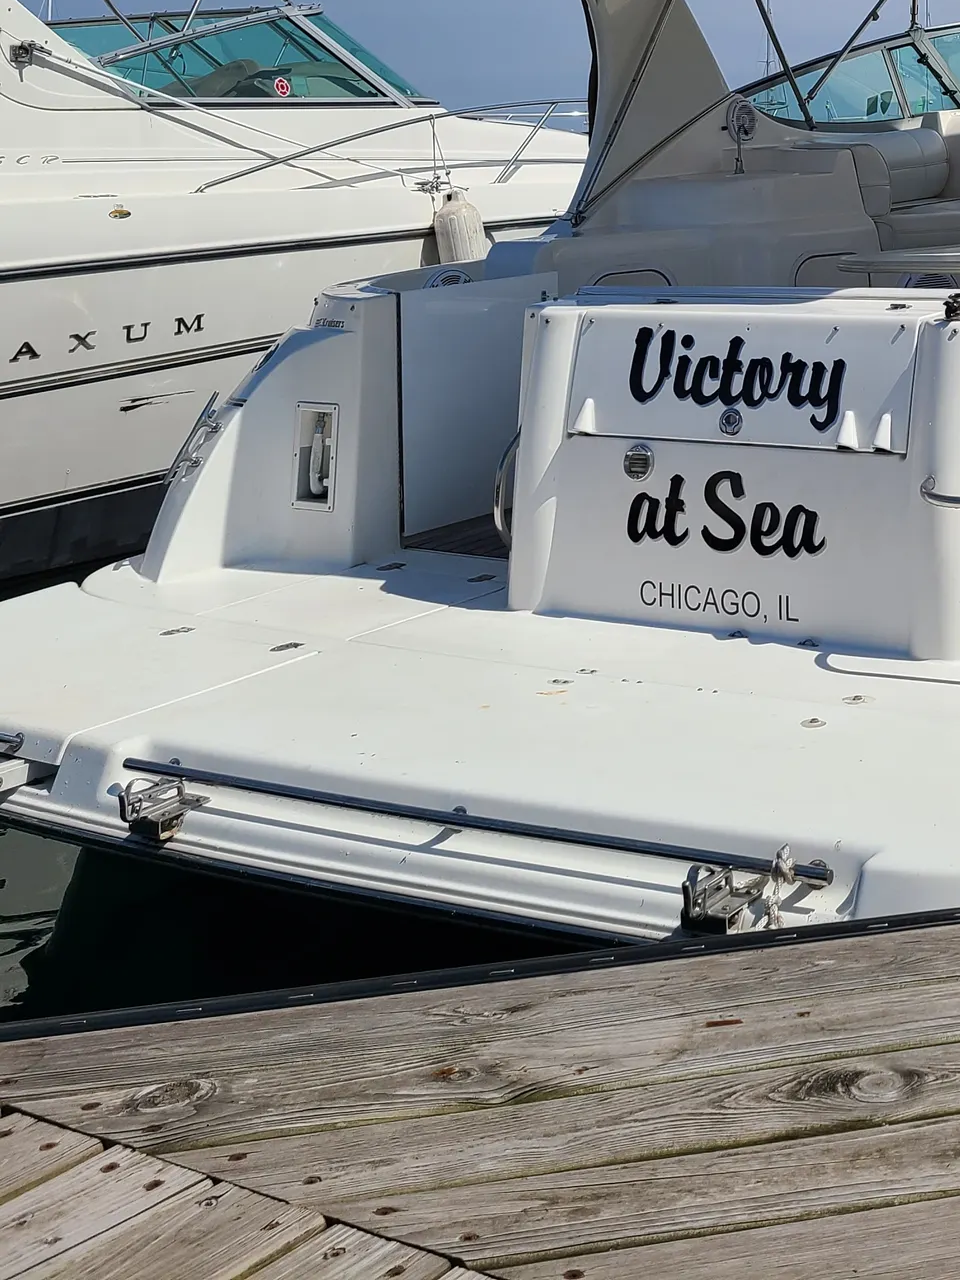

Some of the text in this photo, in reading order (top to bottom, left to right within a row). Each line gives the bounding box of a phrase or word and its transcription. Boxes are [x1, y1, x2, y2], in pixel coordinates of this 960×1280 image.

[628, 326, 848, 432] Victory
[626, 469, 828, 558] at Sea
[639, 579, 800, 623] CHICAGO, IL
